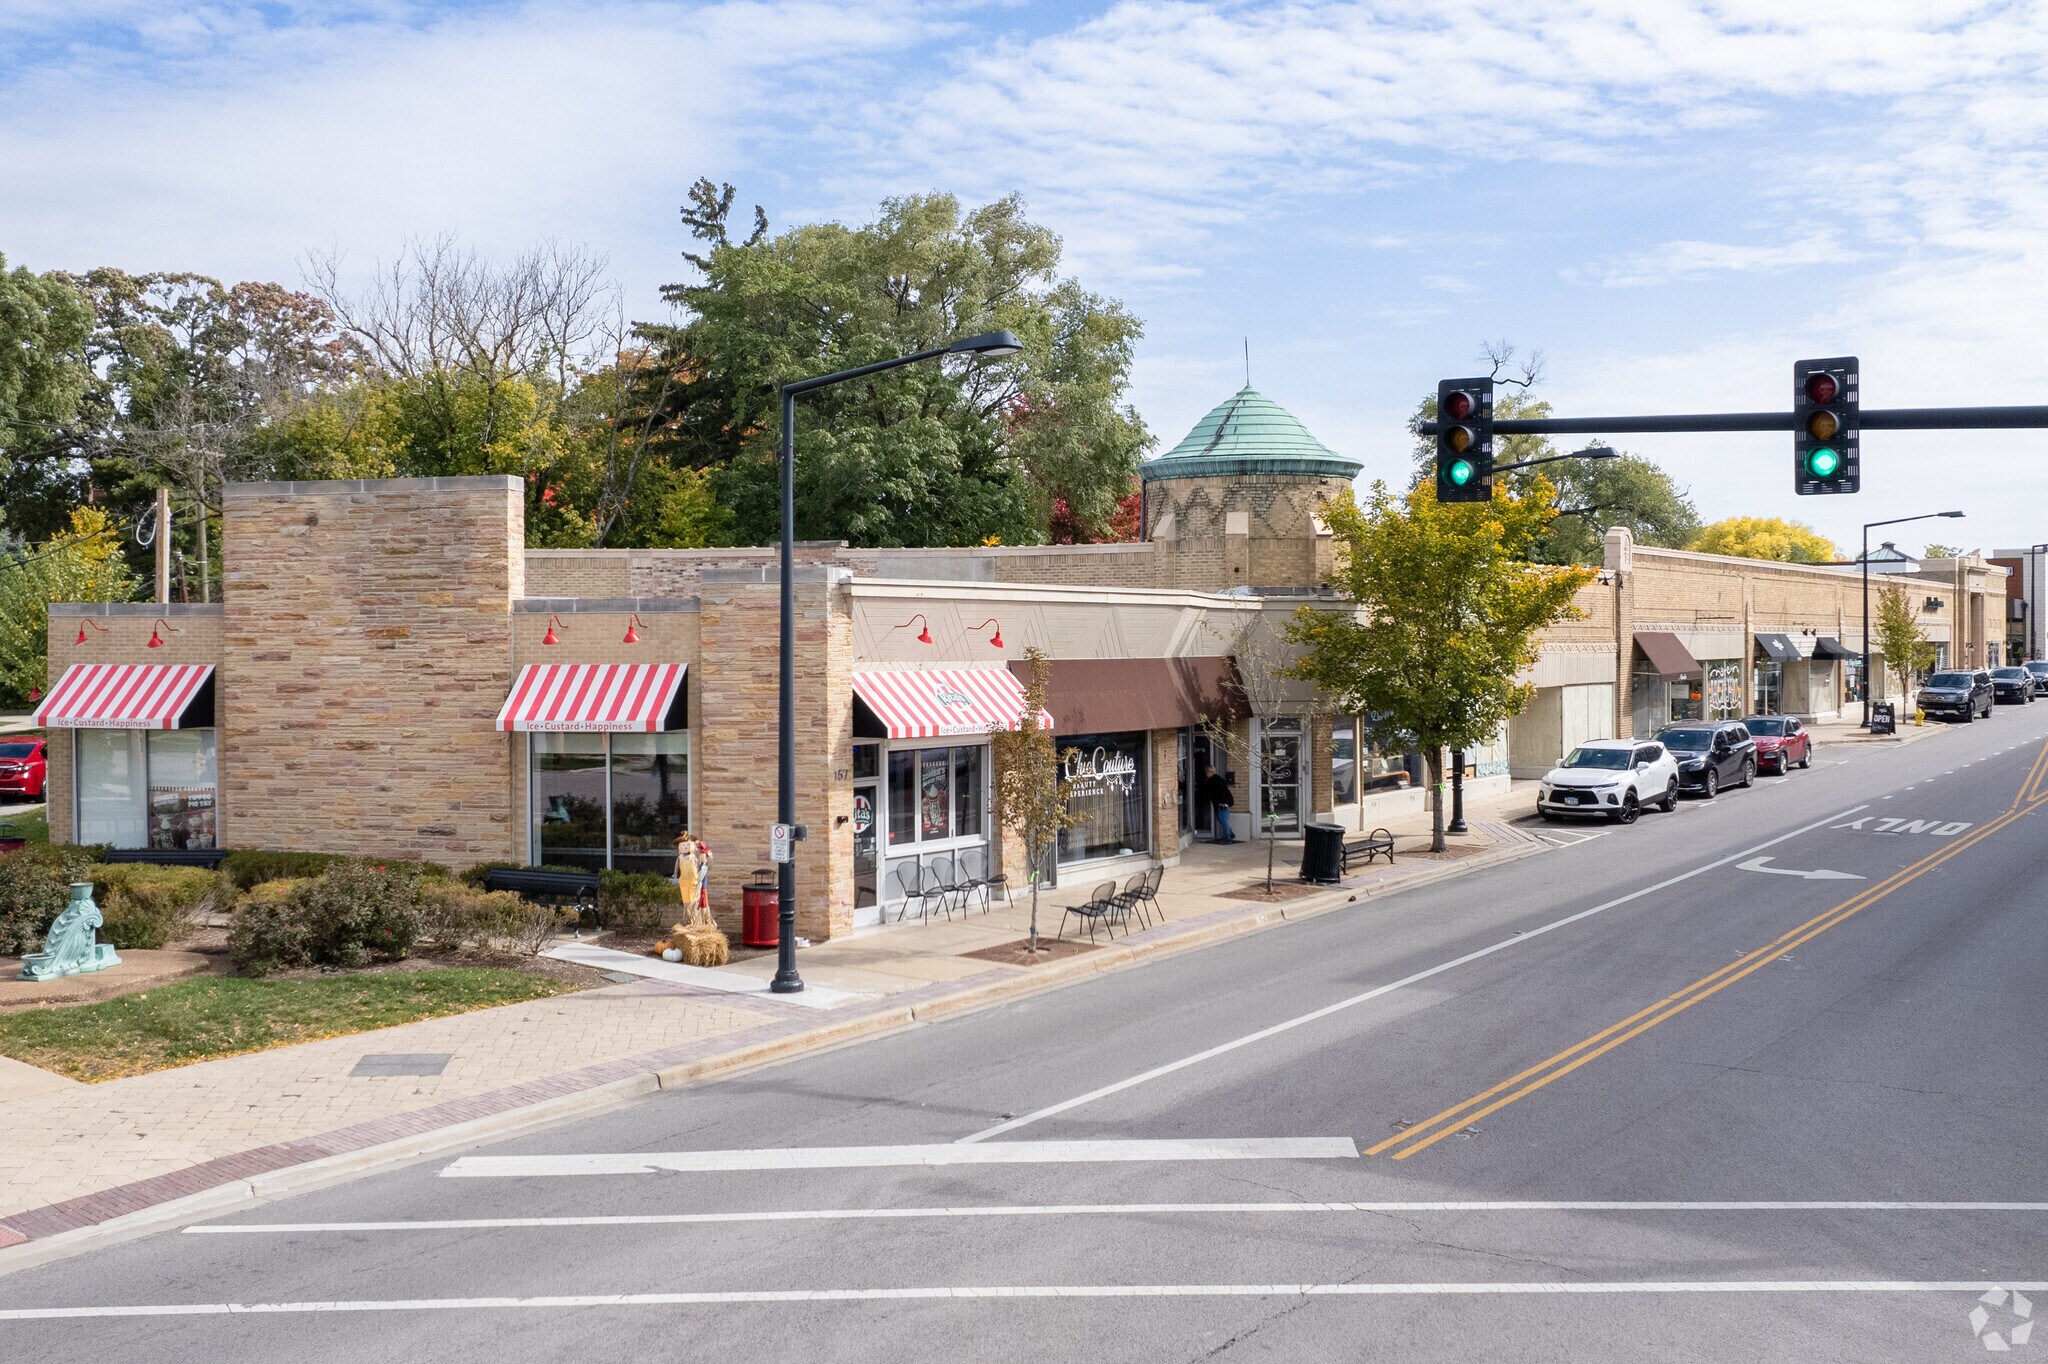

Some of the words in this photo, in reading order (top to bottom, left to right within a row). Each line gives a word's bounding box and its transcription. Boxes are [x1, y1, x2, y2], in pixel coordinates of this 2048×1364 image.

[1873, 714, 1890, 723] OPEN
[73, 719, 104, 727] Custard
[109, 719, 151, 729] Happiness
[526, 722, 539, 731] Ice
[544, 722, 580, 731] Custard
[585, 722, 633, 732] Happiness
[952, 725, 975, 734] Custard
[1093, 746, 1135, 780] Couture
[833, 769, 849, 781] 157
[1072, 780, 1097, 790] BEAUTY
[1067, 787, 1104, 798] XPERIENCE
[1828, 816, 1974, 836] ONLY
